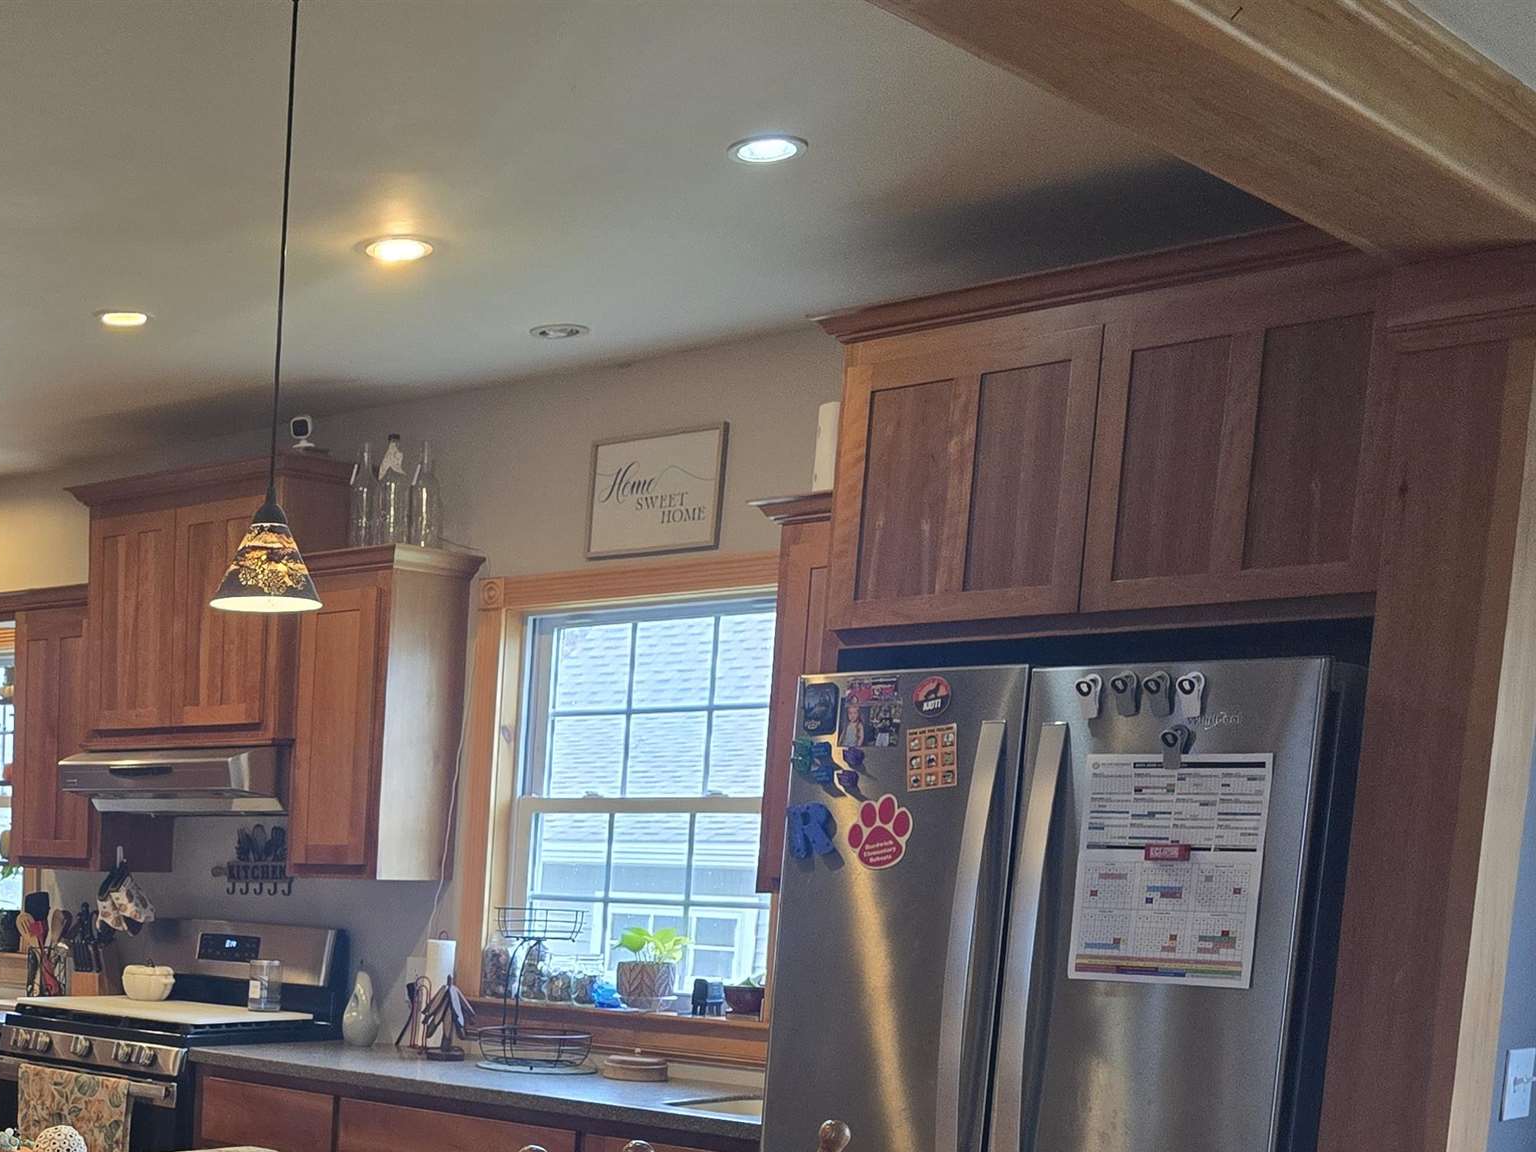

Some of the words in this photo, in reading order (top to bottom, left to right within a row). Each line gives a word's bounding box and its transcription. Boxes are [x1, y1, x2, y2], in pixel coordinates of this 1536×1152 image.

[600, 461, 656, 504] Home
[635, 492, 688, 511] SWEET
[660, 506, 706, 524] HOME
